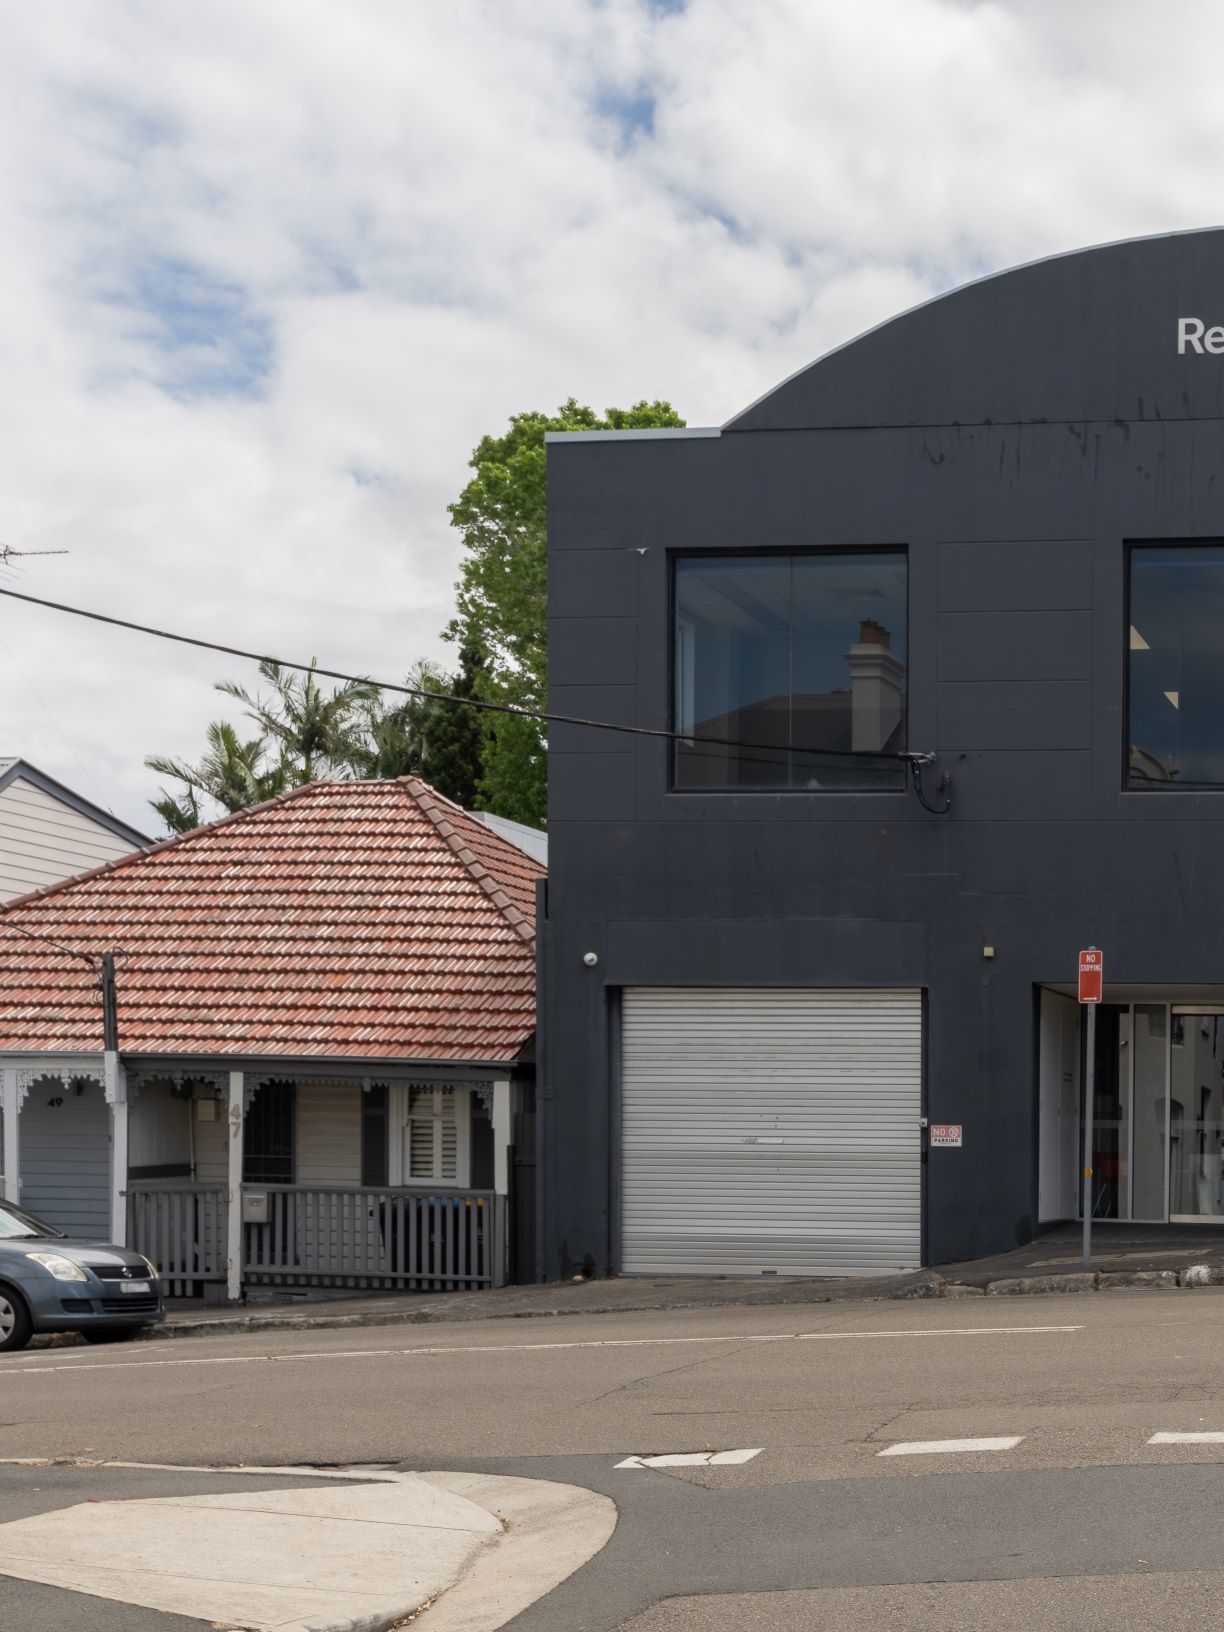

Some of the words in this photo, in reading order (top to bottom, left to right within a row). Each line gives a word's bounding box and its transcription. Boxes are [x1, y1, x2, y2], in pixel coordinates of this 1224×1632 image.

[1086, 954, 1096, 963] NO
[47, 1096, 64, 1108] 49
[933, 1127, 946, 1137] NO
